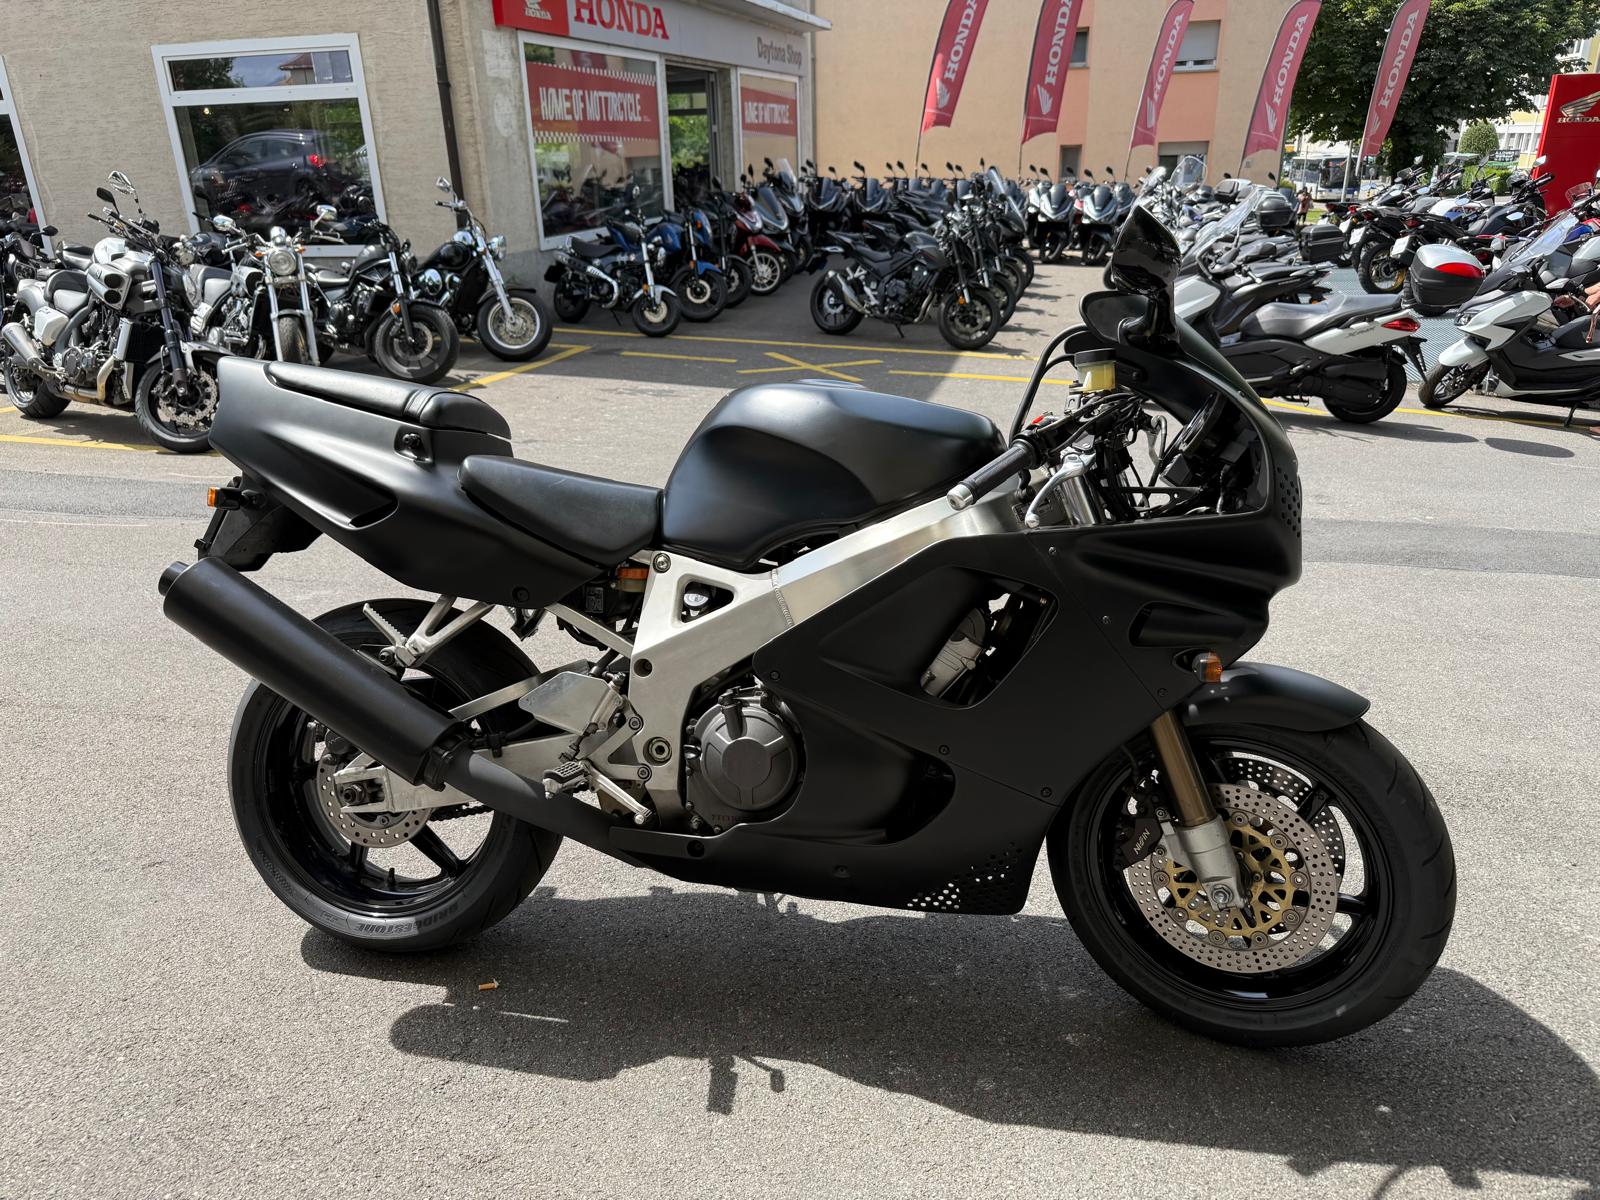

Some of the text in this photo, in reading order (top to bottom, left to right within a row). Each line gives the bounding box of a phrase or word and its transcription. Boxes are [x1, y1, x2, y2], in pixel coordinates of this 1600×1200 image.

[574, 0, 669, 40] HONDA
[757, 36, 802, 69] Daytona Shop
[1154, 13, 1184, 103] HONDA
[1273, 14, 1308, 106] HONDA
[1378, 10, 1419, 109] HONDA
[539, 87, 572, 121] HOME
[572, 88, 584, 121] OF
